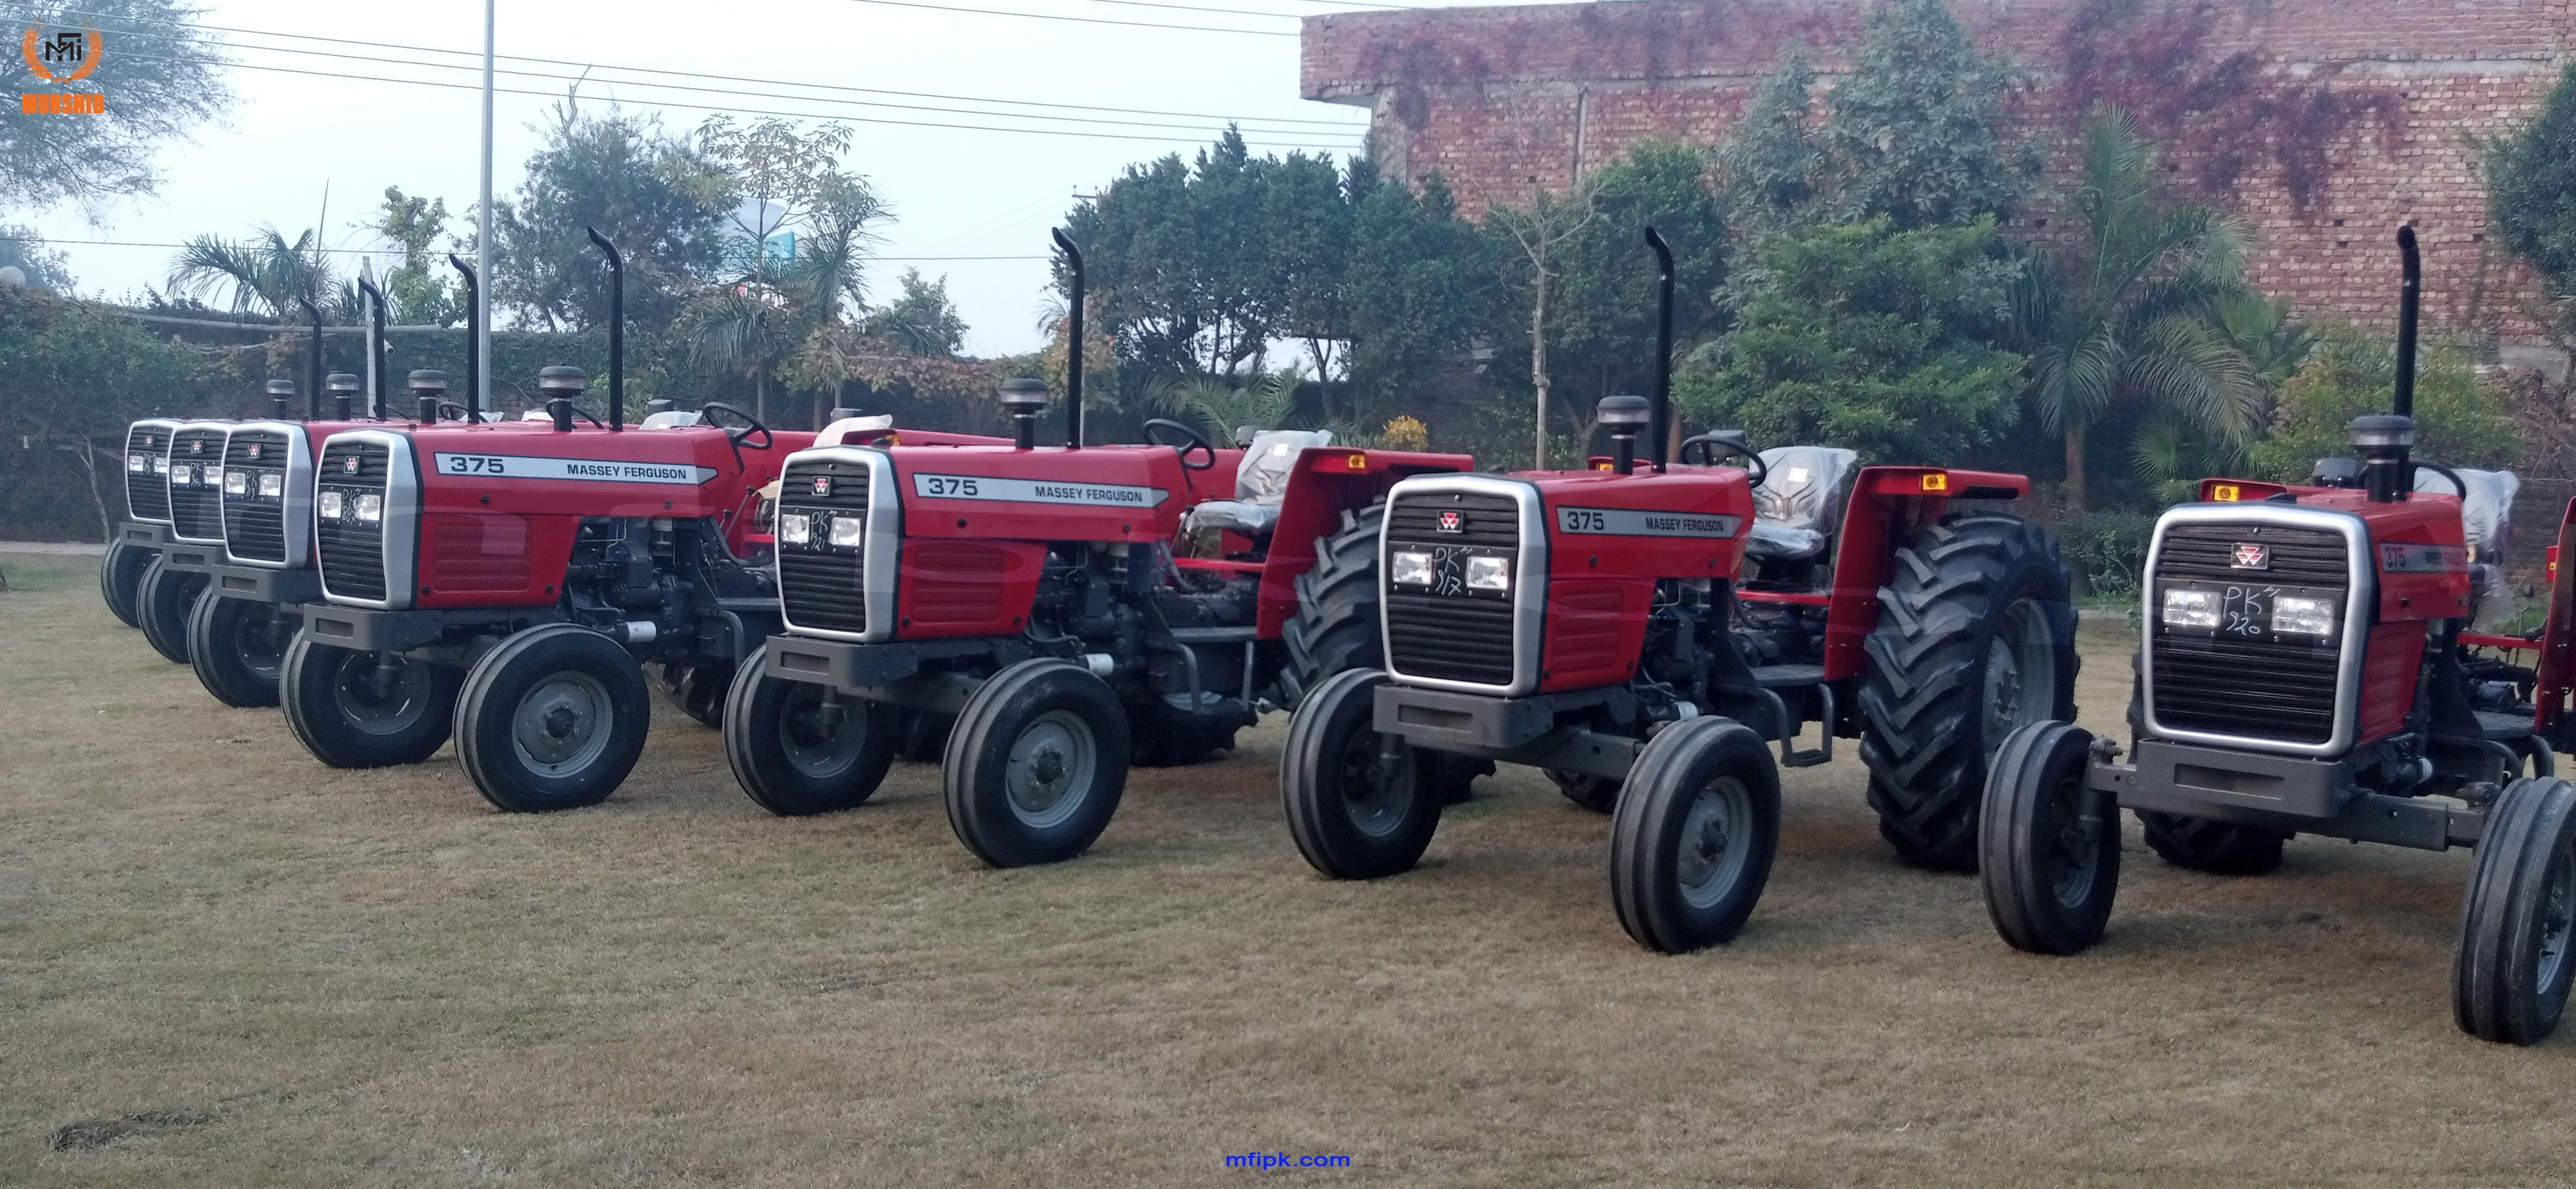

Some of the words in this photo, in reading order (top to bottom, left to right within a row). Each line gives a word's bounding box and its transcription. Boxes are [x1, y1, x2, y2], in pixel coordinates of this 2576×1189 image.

[451, 457, 504, 474] 375
[567, 464, 620, 476] MASSEY
[624, 467, 686, 479] FERGUSON
[928, 478, 978, 495] 375
[1035, 485, 1082, 498] MASSEY
[1086, 489, 1142, 502] FERGUSON
[1567, 511, 1604, 530] 375
[1645, 517, 1680, 531] MASSEY
[1682, 519, 1723, 532] FERGUSON
